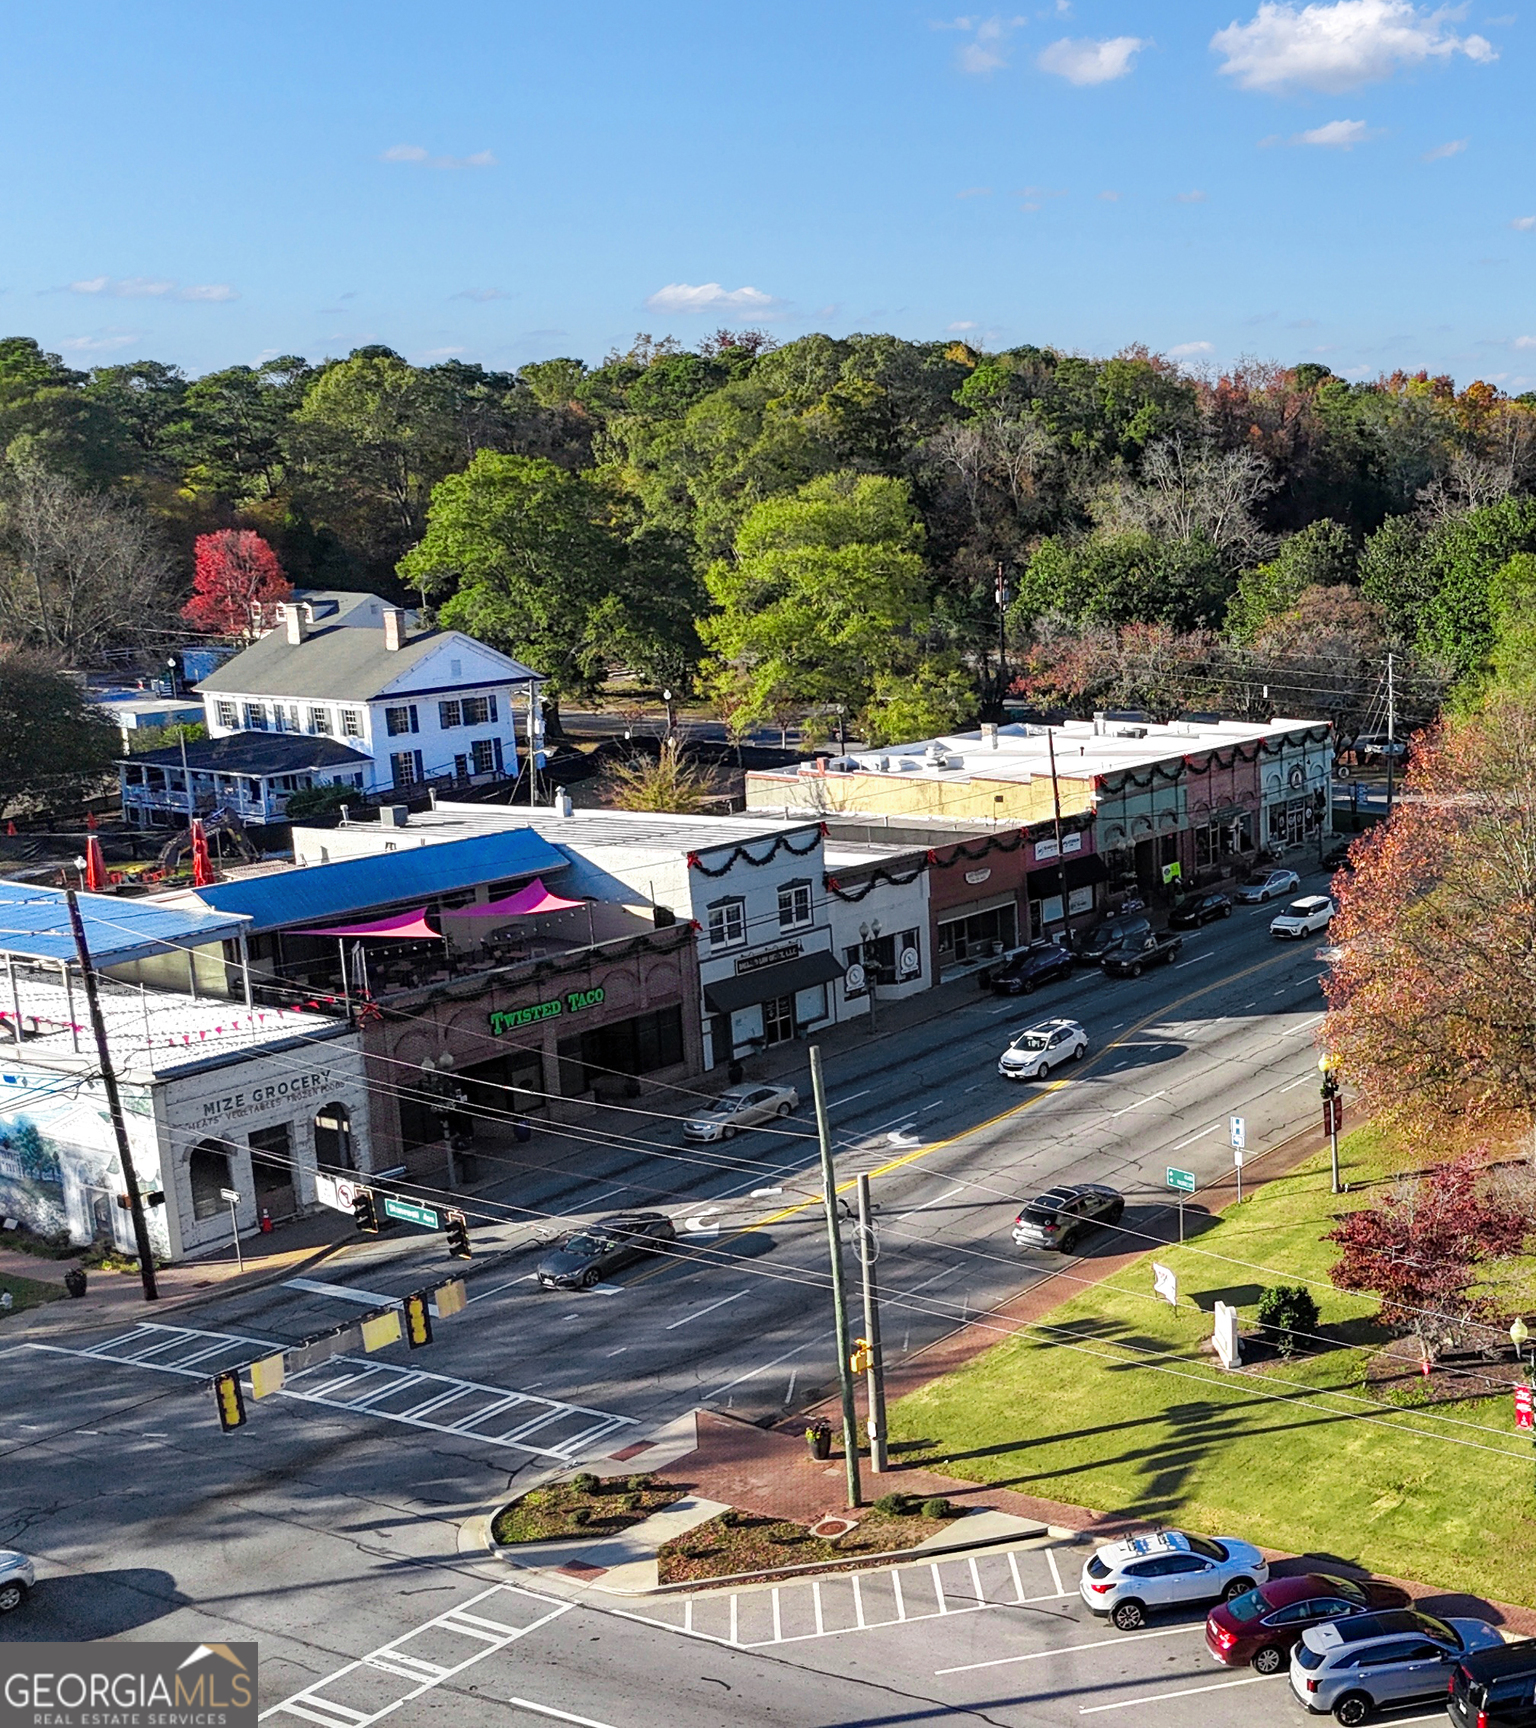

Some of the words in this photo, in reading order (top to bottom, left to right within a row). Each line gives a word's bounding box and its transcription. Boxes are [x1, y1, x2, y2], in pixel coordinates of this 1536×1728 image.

[490, 1000, 562, 1035] TWISTED
[568, 988, 604, 1012] TACO
[203, 1093, 245, 1117] MIZE
[252, 1070, 331, 1102] GROCERY
